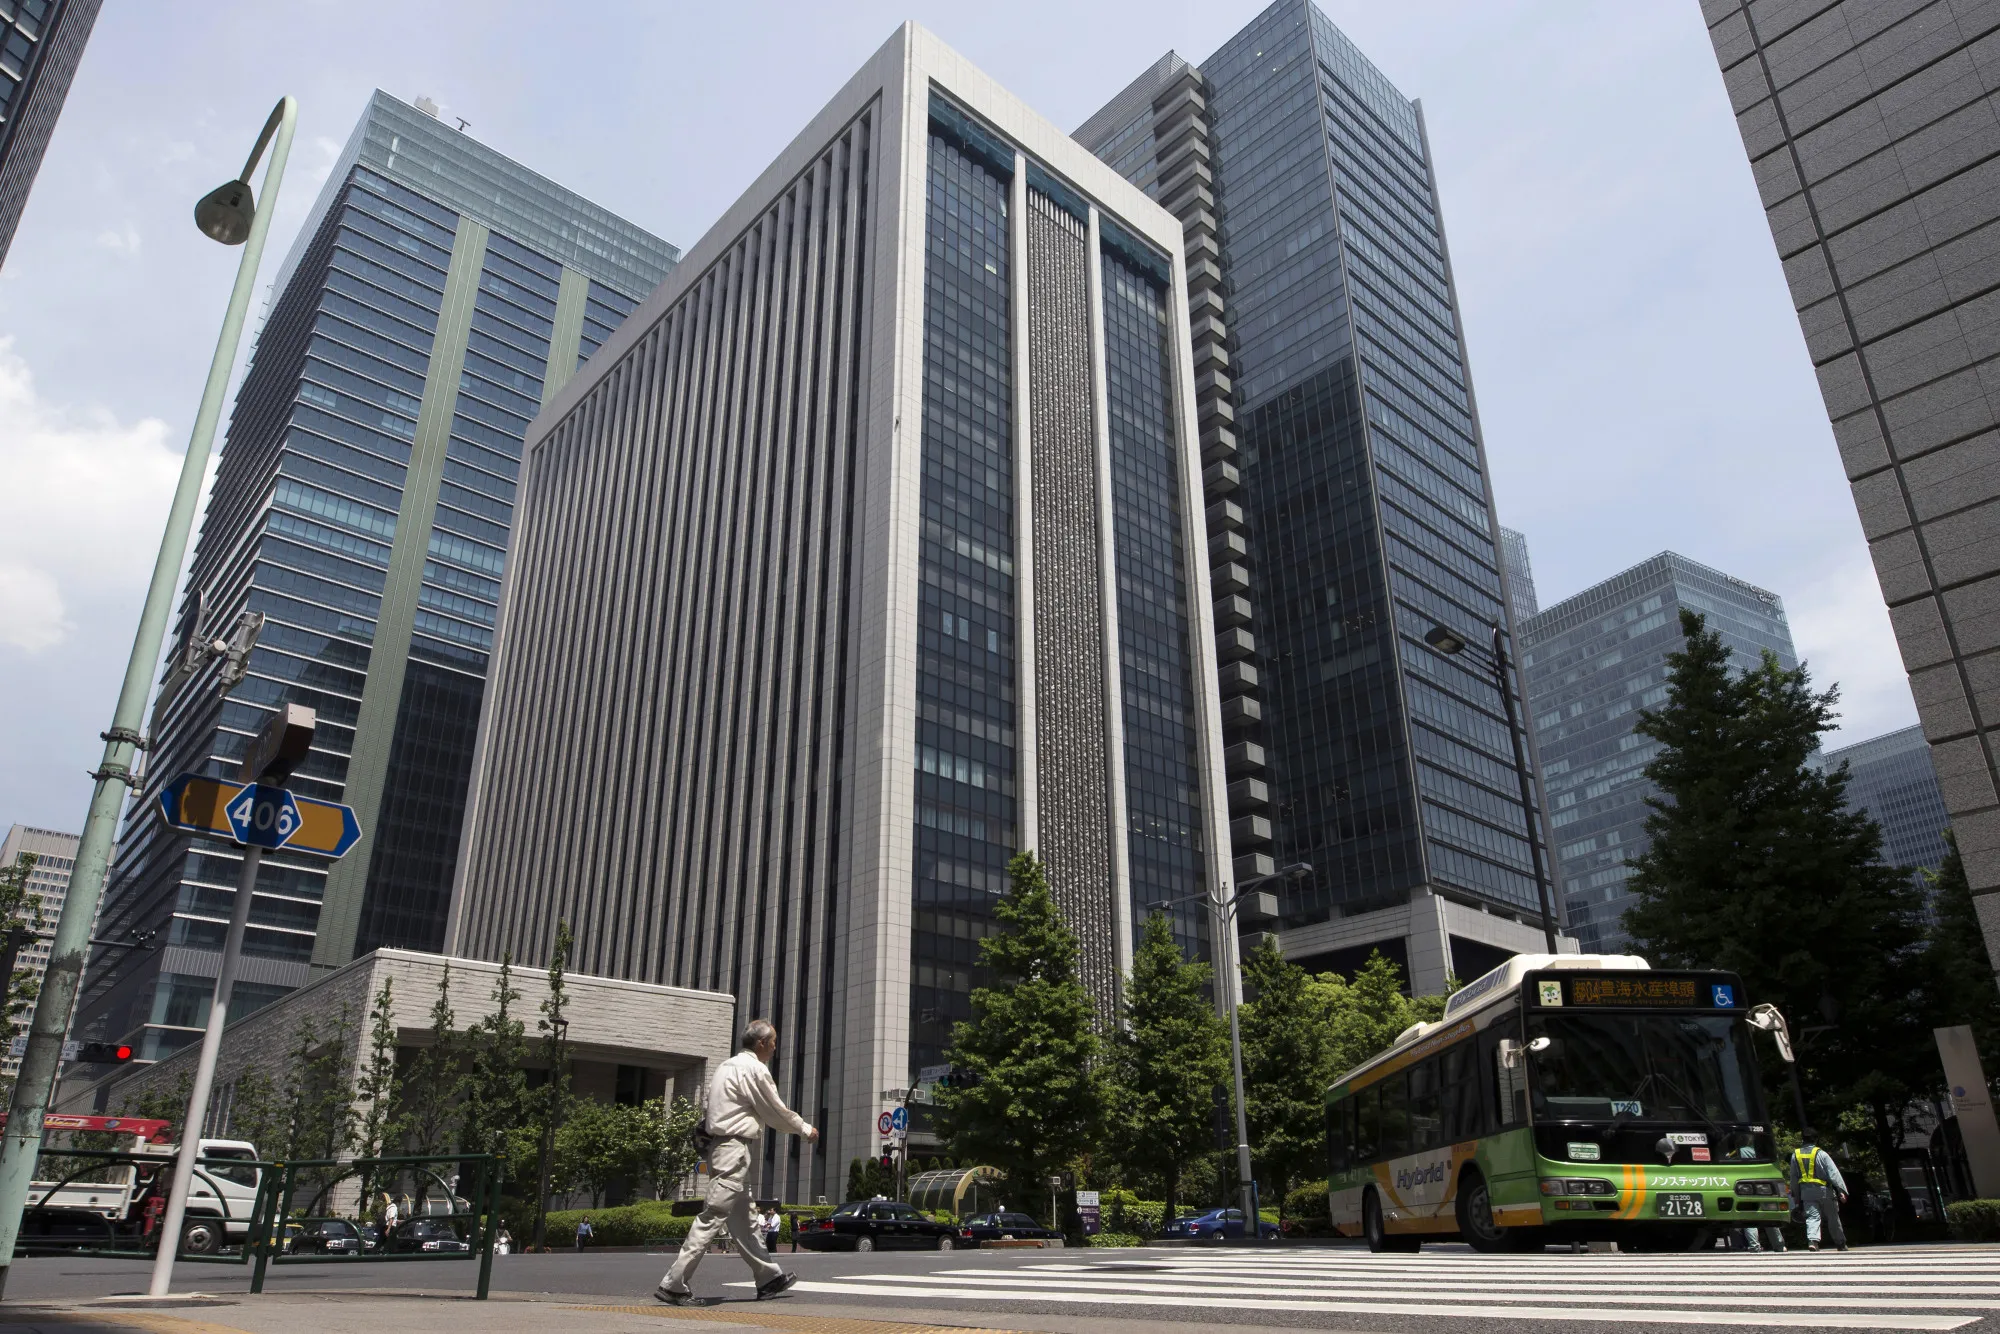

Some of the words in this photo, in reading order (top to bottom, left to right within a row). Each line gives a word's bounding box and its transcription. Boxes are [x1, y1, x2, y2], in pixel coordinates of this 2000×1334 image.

[233, 797, 294, 834] 406
[1454, 979, 1488, 1006] Hybrid
[1600, 979, 1697, 998] 豊海水産埠頭
[1747, 1125, 1764, 1133] T280
[1396, 1161, 1444, 1190] Hybrid
[1651, 1176, 1730, 1187] ノンステップバス
[1666, 1200, 1703, 1216] 21-28
